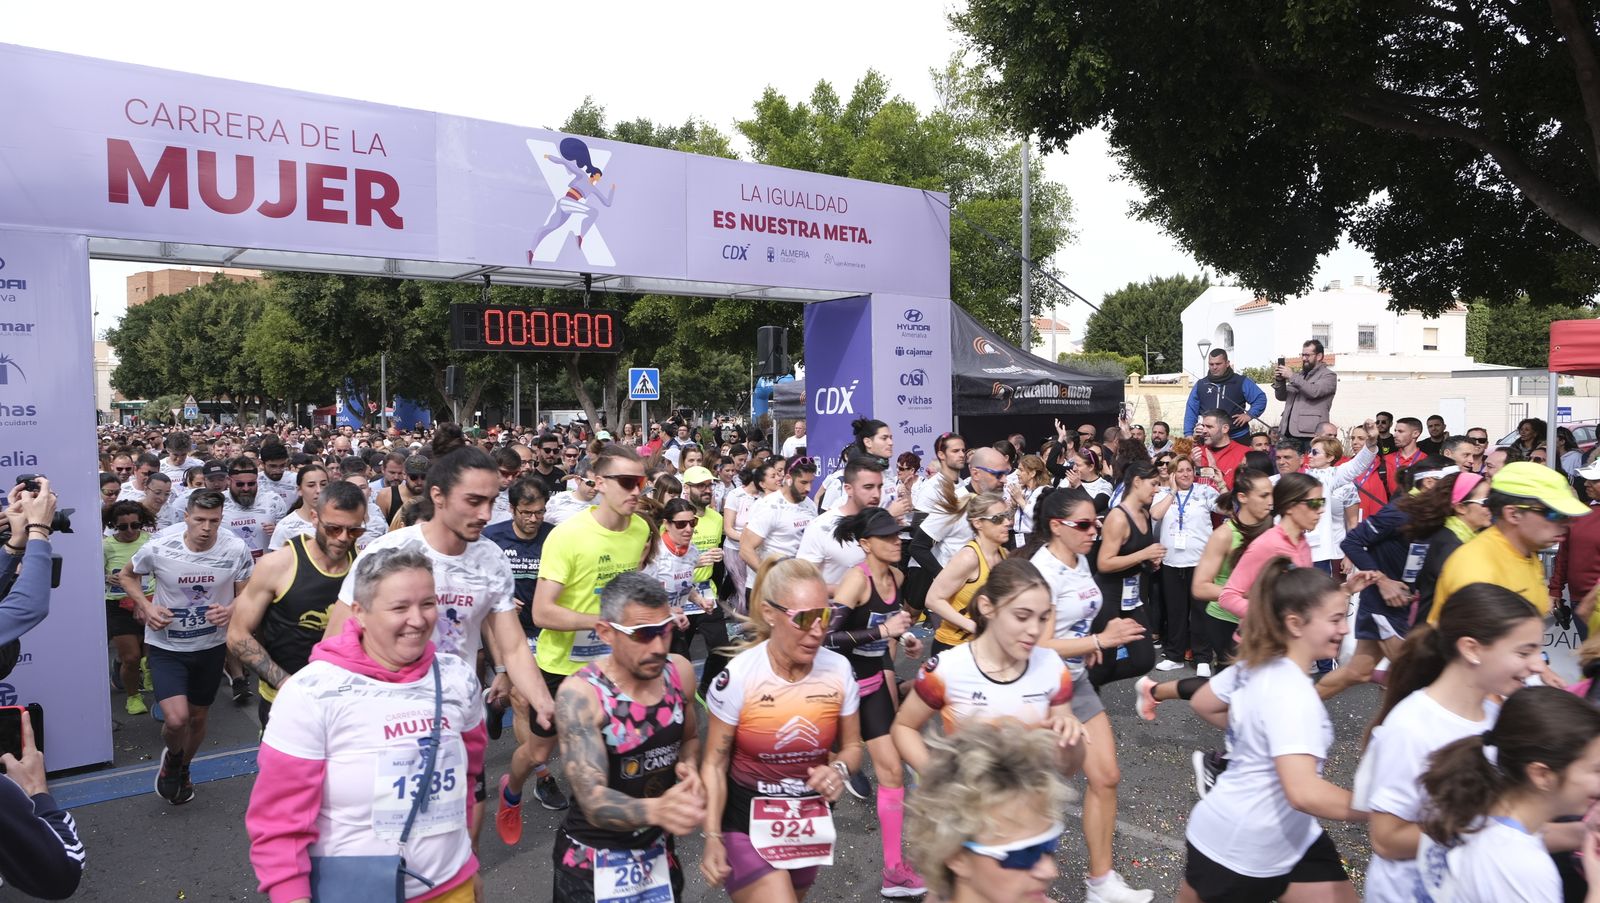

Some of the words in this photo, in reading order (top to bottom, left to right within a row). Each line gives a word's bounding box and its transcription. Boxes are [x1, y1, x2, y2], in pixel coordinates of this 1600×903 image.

[125, 98, 289, 144] CARRERA
[301, 123, 340, 151] DE
[352, 129, 387, 157] LA
[107, 138, 404, 230] MUJER
[741, 183, 762, 203] LA
[767, 187, 848, 214] IGUALDAD
[713, 210, 736, 229] ES
[740, 213, 821, 239] NUESTRA
[823, 224, 873, 245] META.
[722, 244, 750, 260] CDX
[484, 309, 613, 348] 00:00:00
[906, 347, 933, 357] cajamar
[900, 373, 924, 386] CASI
[815, 381, 859, 414] CDX
[908, 396, 932, 405] vithas
[904, 425, 932, 435] aqualia
[231, 518, 256, 528] MUJER
[178, 575, 215, 584] MUJER
[436, 593, 474, 607] MUJER
[180, 616, 206, 627] 133
[392, 768, 456, 800] 1385
[771, 819, 815, 838] 924
